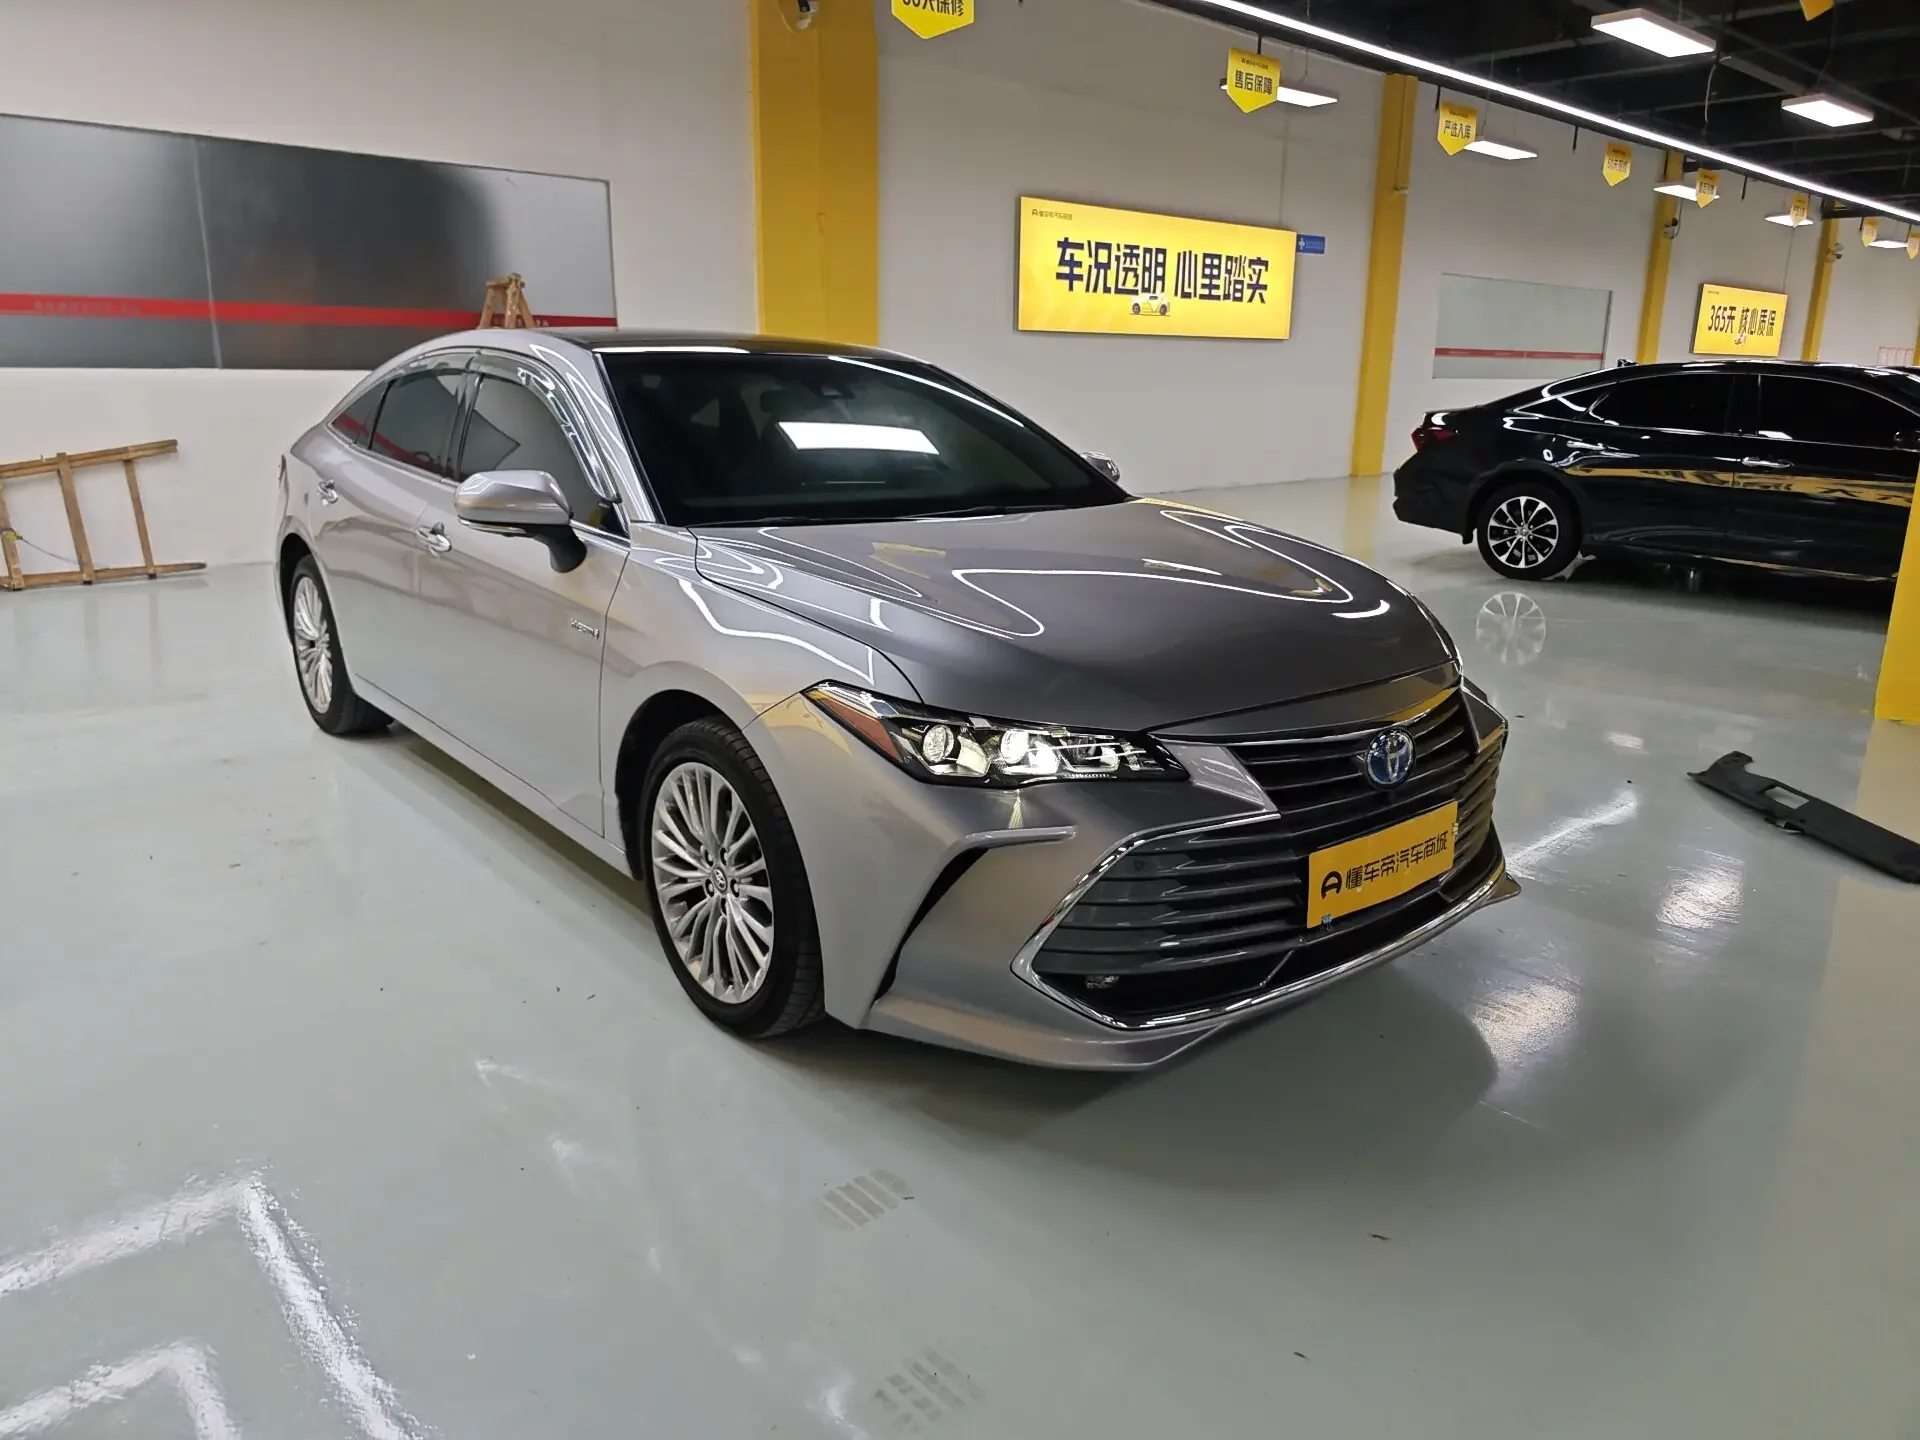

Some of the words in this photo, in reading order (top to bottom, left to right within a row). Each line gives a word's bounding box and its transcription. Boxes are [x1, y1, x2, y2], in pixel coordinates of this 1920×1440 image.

[1235, 69, 1273, 95] 售后保障
[1056, 237, 1167, 296] 车况透明
[1174, 250, 1269, 304] 心里踏实
[1708, 305, 1737, 334] 365天
[1345, 830, 1448, 890] 懂车帝汽车商城
